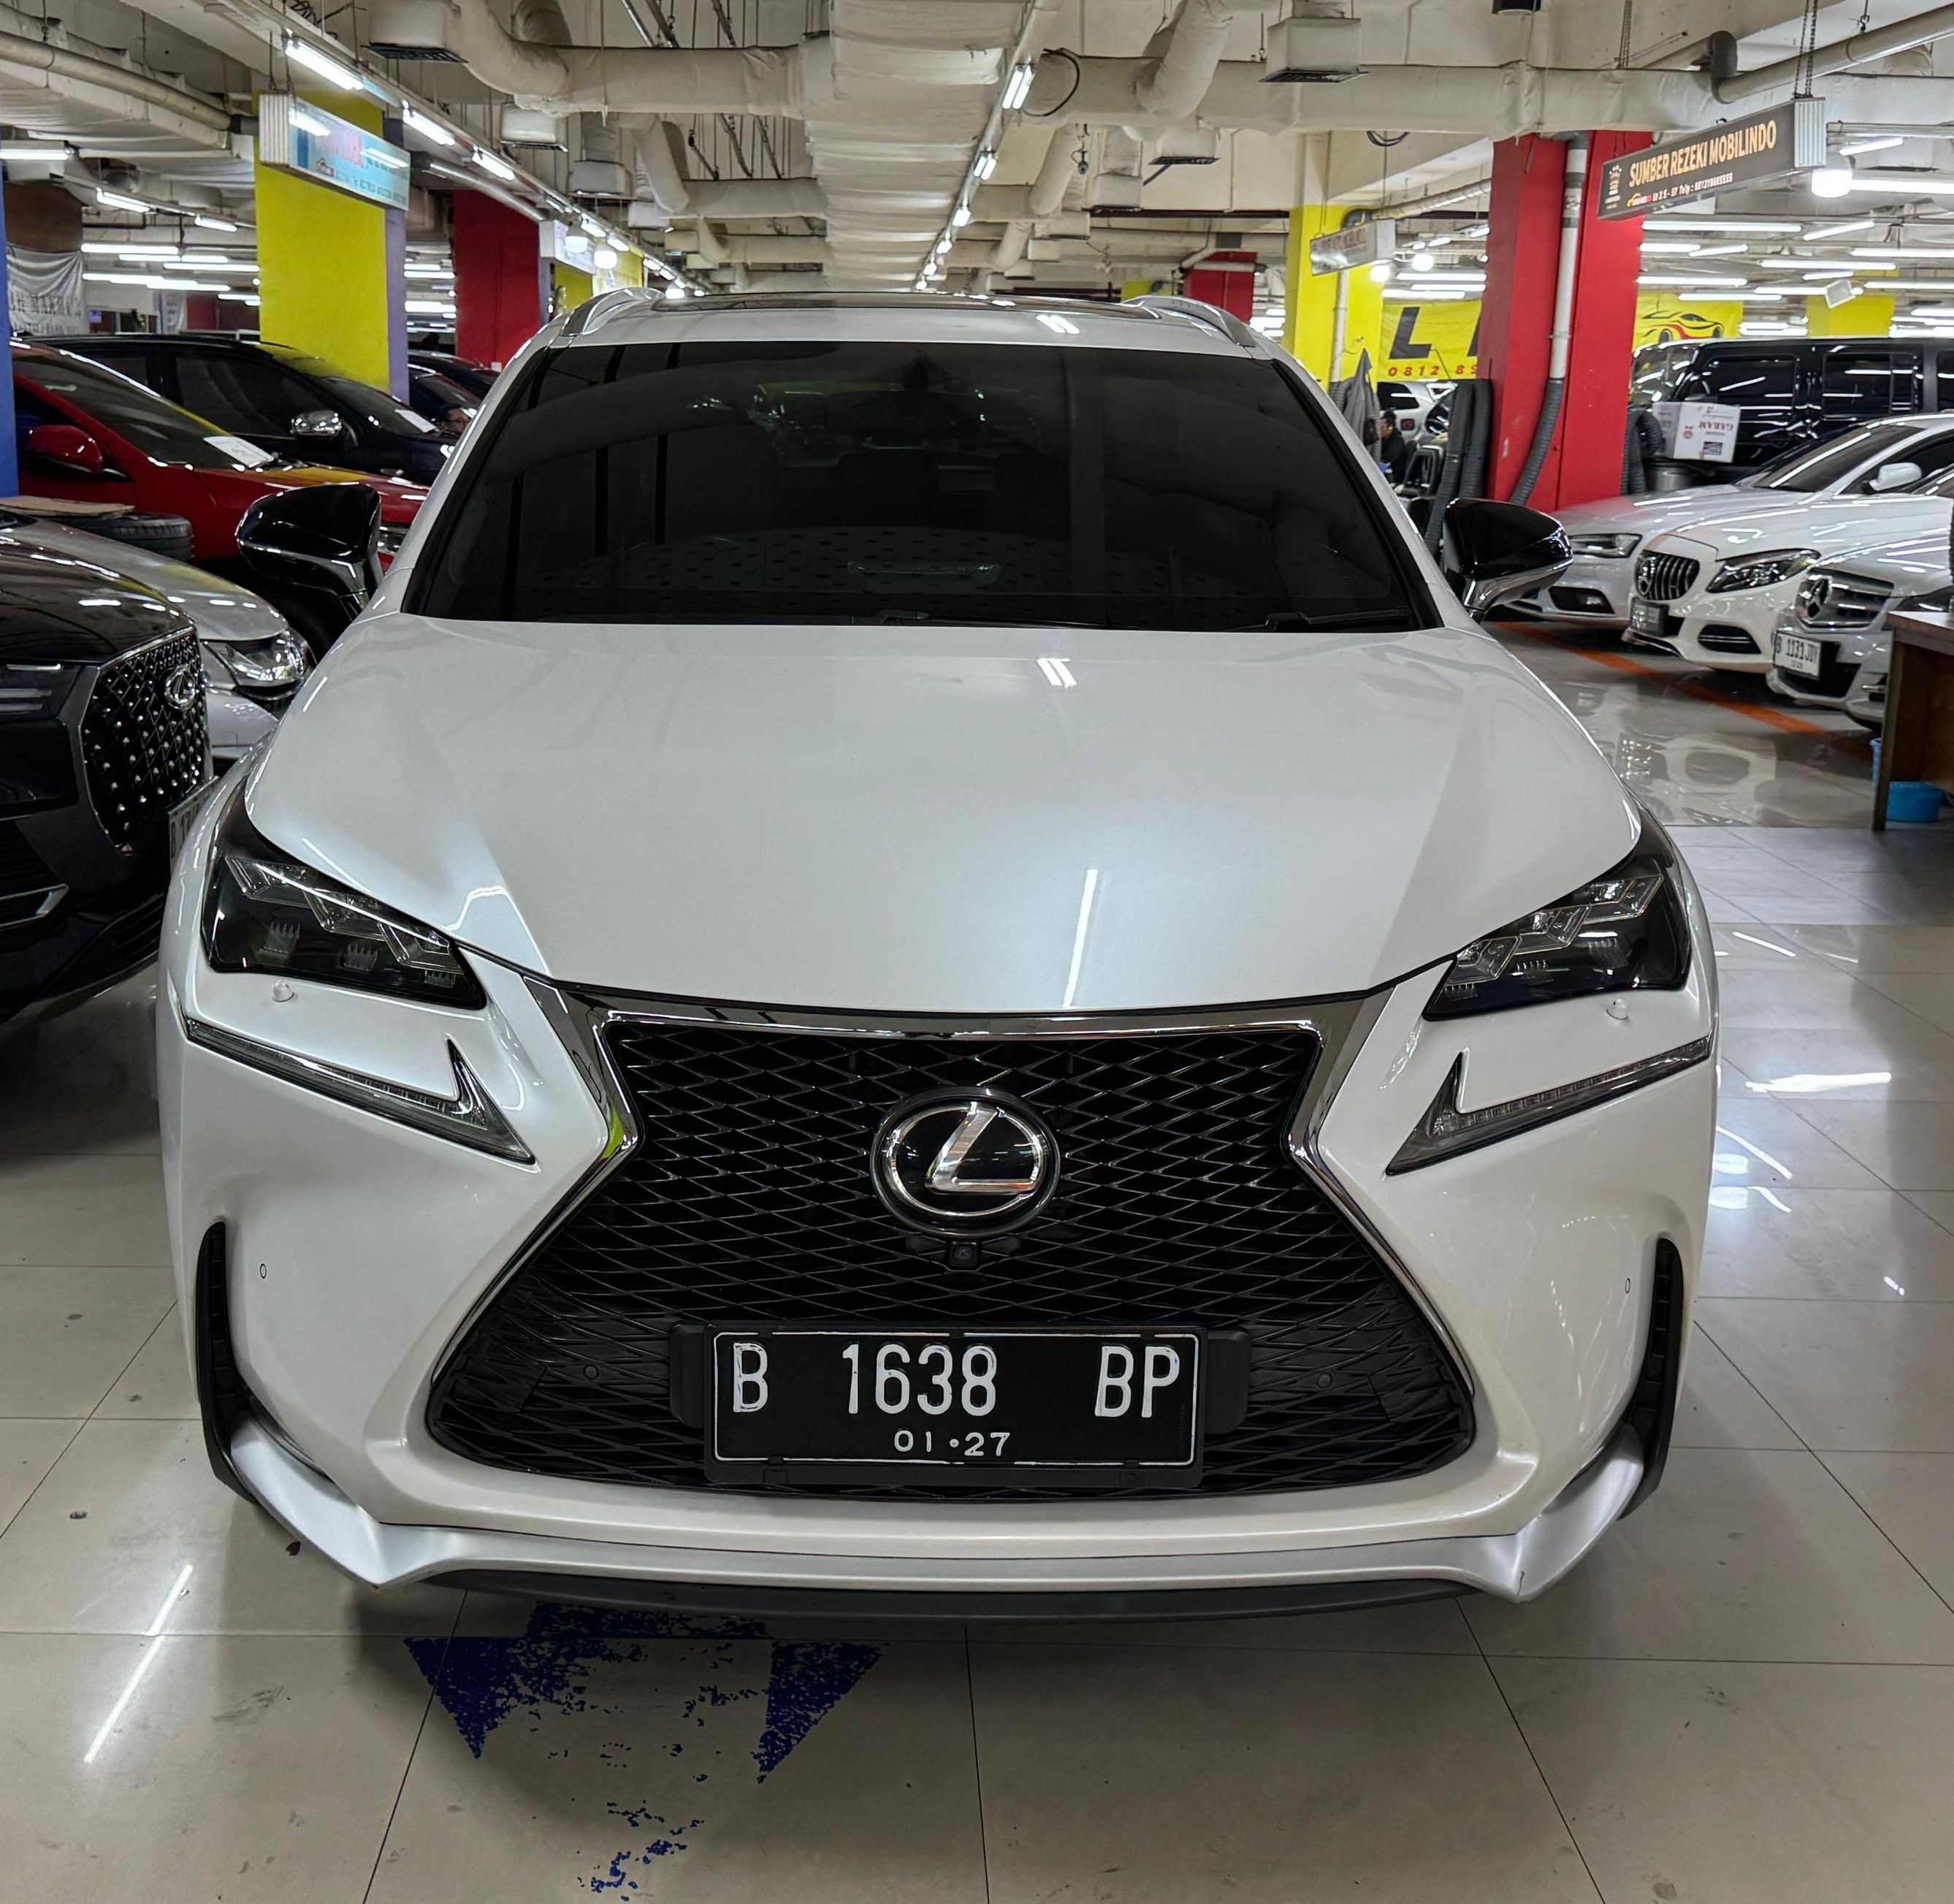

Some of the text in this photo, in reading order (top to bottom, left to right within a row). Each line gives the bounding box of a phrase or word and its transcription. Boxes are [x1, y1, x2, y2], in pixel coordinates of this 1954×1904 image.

[1629, 153, 1670, 188] SUMBER
[1671, 142, 1708, 176] REZEKI
[1709, 120, 1778, 166] MOBILINDO
[1389, 365, 1440, 377] 0812
[733, 1342, 1180, 1418] B 1638 BP
